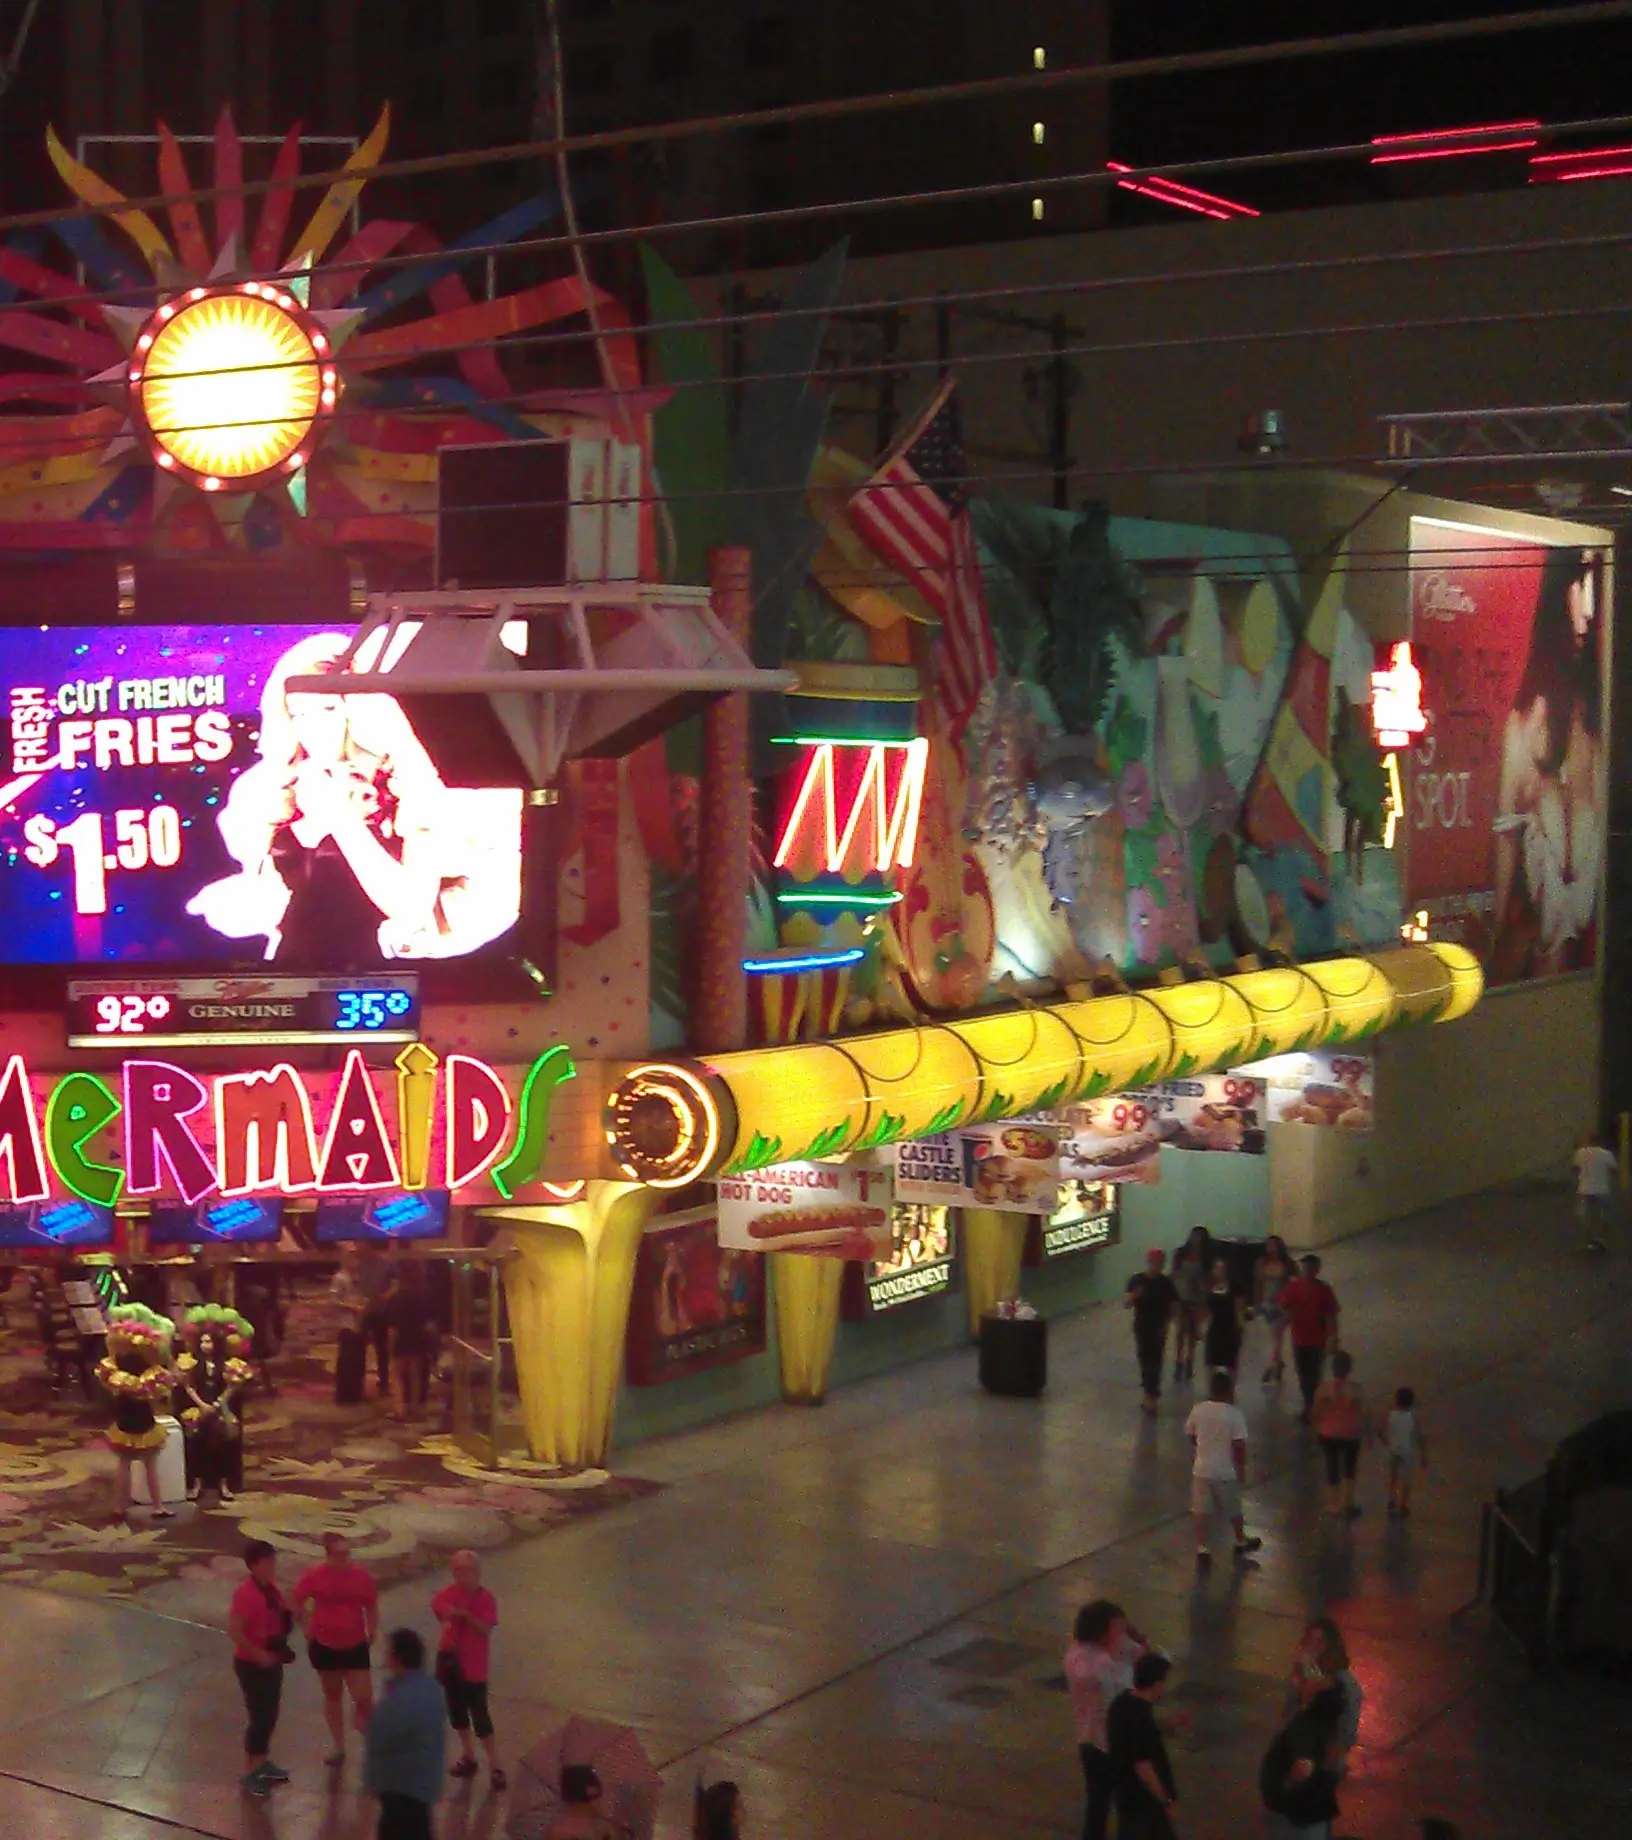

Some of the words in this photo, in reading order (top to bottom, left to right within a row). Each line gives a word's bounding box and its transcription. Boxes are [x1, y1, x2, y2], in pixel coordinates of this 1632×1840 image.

[58, 675, 113, 715] CUT
[118, 674, 225, 712] FRENCH
[11, 686, 49, 774] FRESH
[58, 709, 233, 770] FRIES
[23, 804, 180, 915] $1.50
[188, 1003, 296, 1019] GENUINE
[899, 1144, 956, 1165] CASTLE
[898, 1162, 961, 1183] SLIDERS
[720, 1183, 751, 1202] HOT
[757, 1185, 793, 1204] DOG
